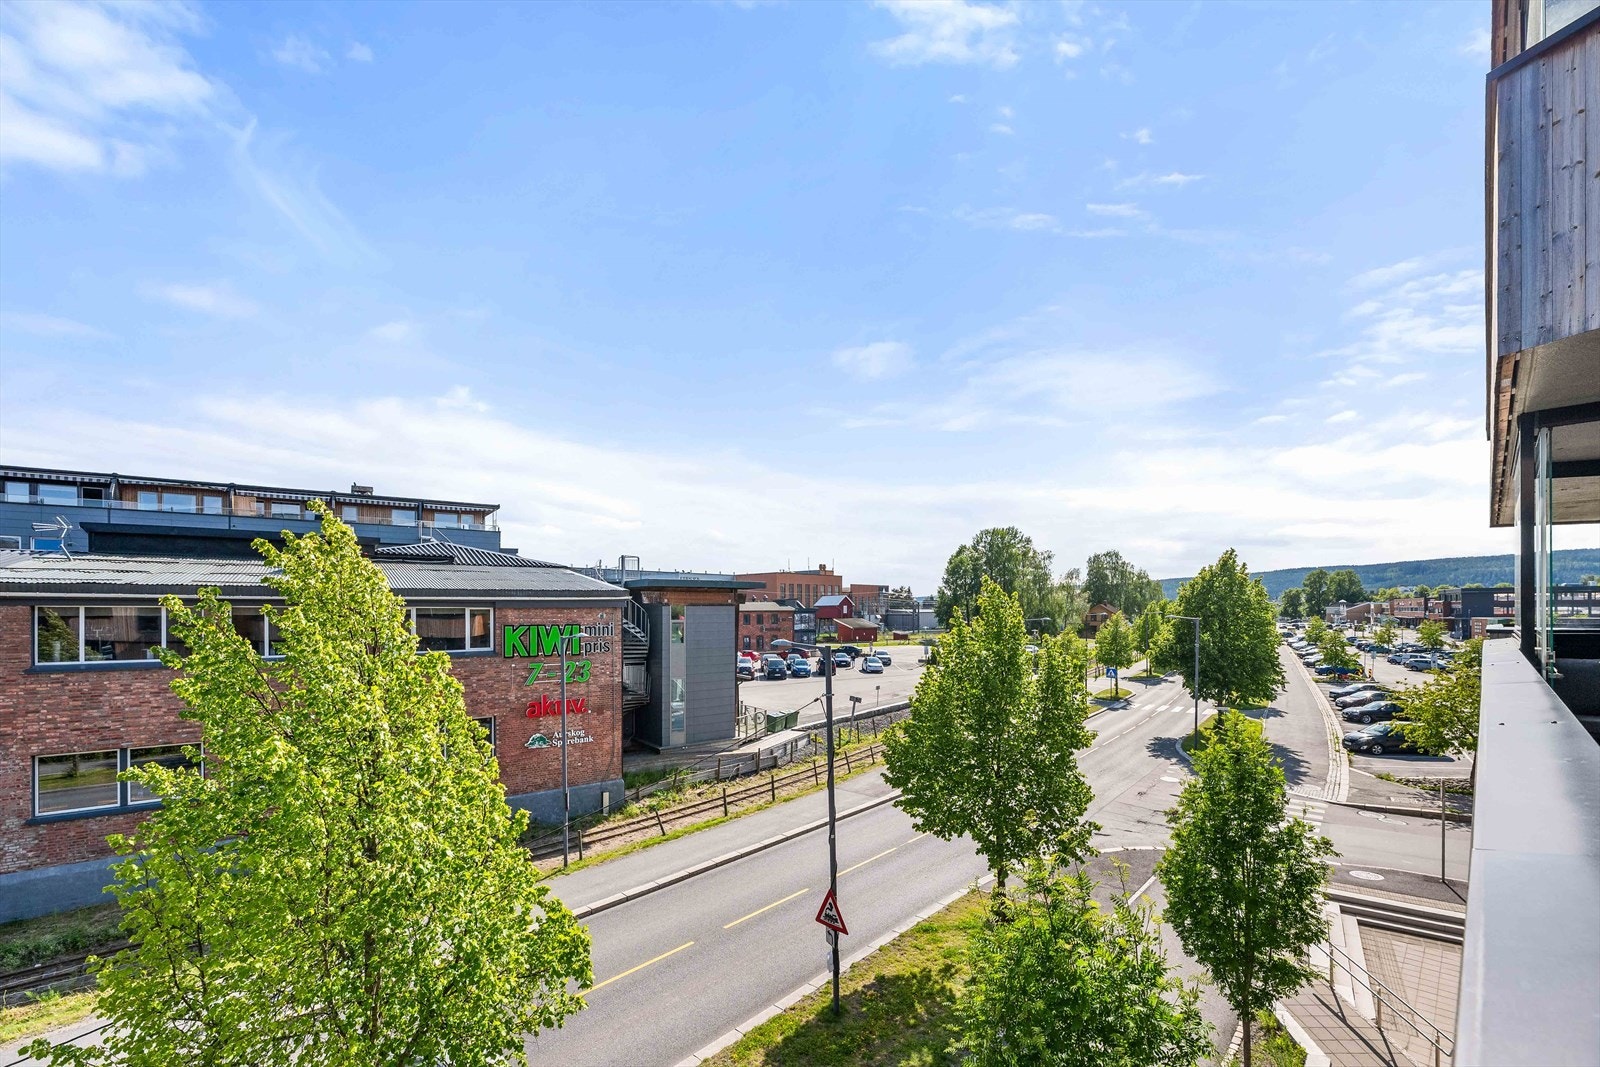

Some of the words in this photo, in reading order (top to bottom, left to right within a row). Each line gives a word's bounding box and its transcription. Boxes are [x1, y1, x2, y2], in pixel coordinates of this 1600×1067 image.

[584, 622, 614, 637] mini
[504, 624, 581, 658] KIWI
[583, 639, 611, 657] pris
[524, 662, 544, 686] 7
[564, 660, 592, 683] 23
[552, 735, 594, 748] Sprebank
